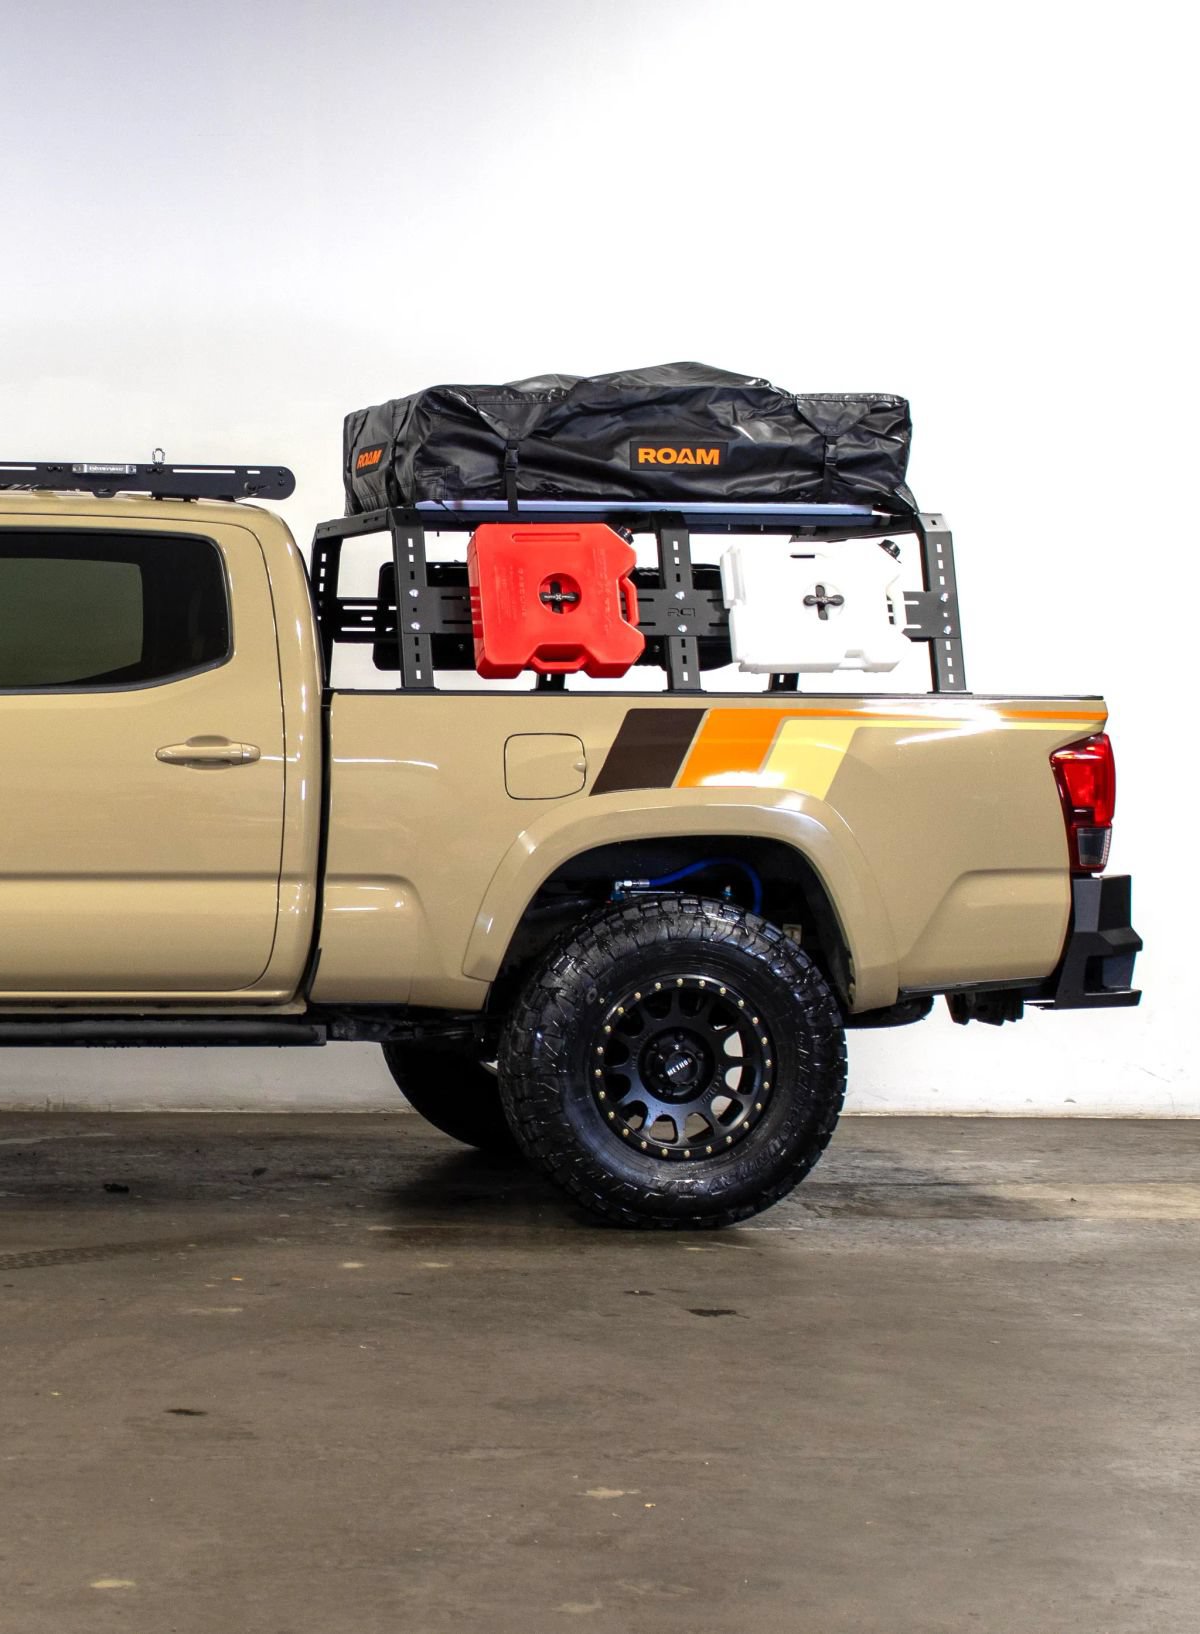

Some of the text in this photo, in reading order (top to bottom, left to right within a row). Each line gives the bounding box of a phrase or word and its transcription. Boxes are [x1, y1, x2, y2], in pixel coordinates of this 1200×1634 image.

[356, 449, 382, 470] ROAM
[637, 447, 720, 465] ROAM
[666, 1057, 693, 1077] METHOD
